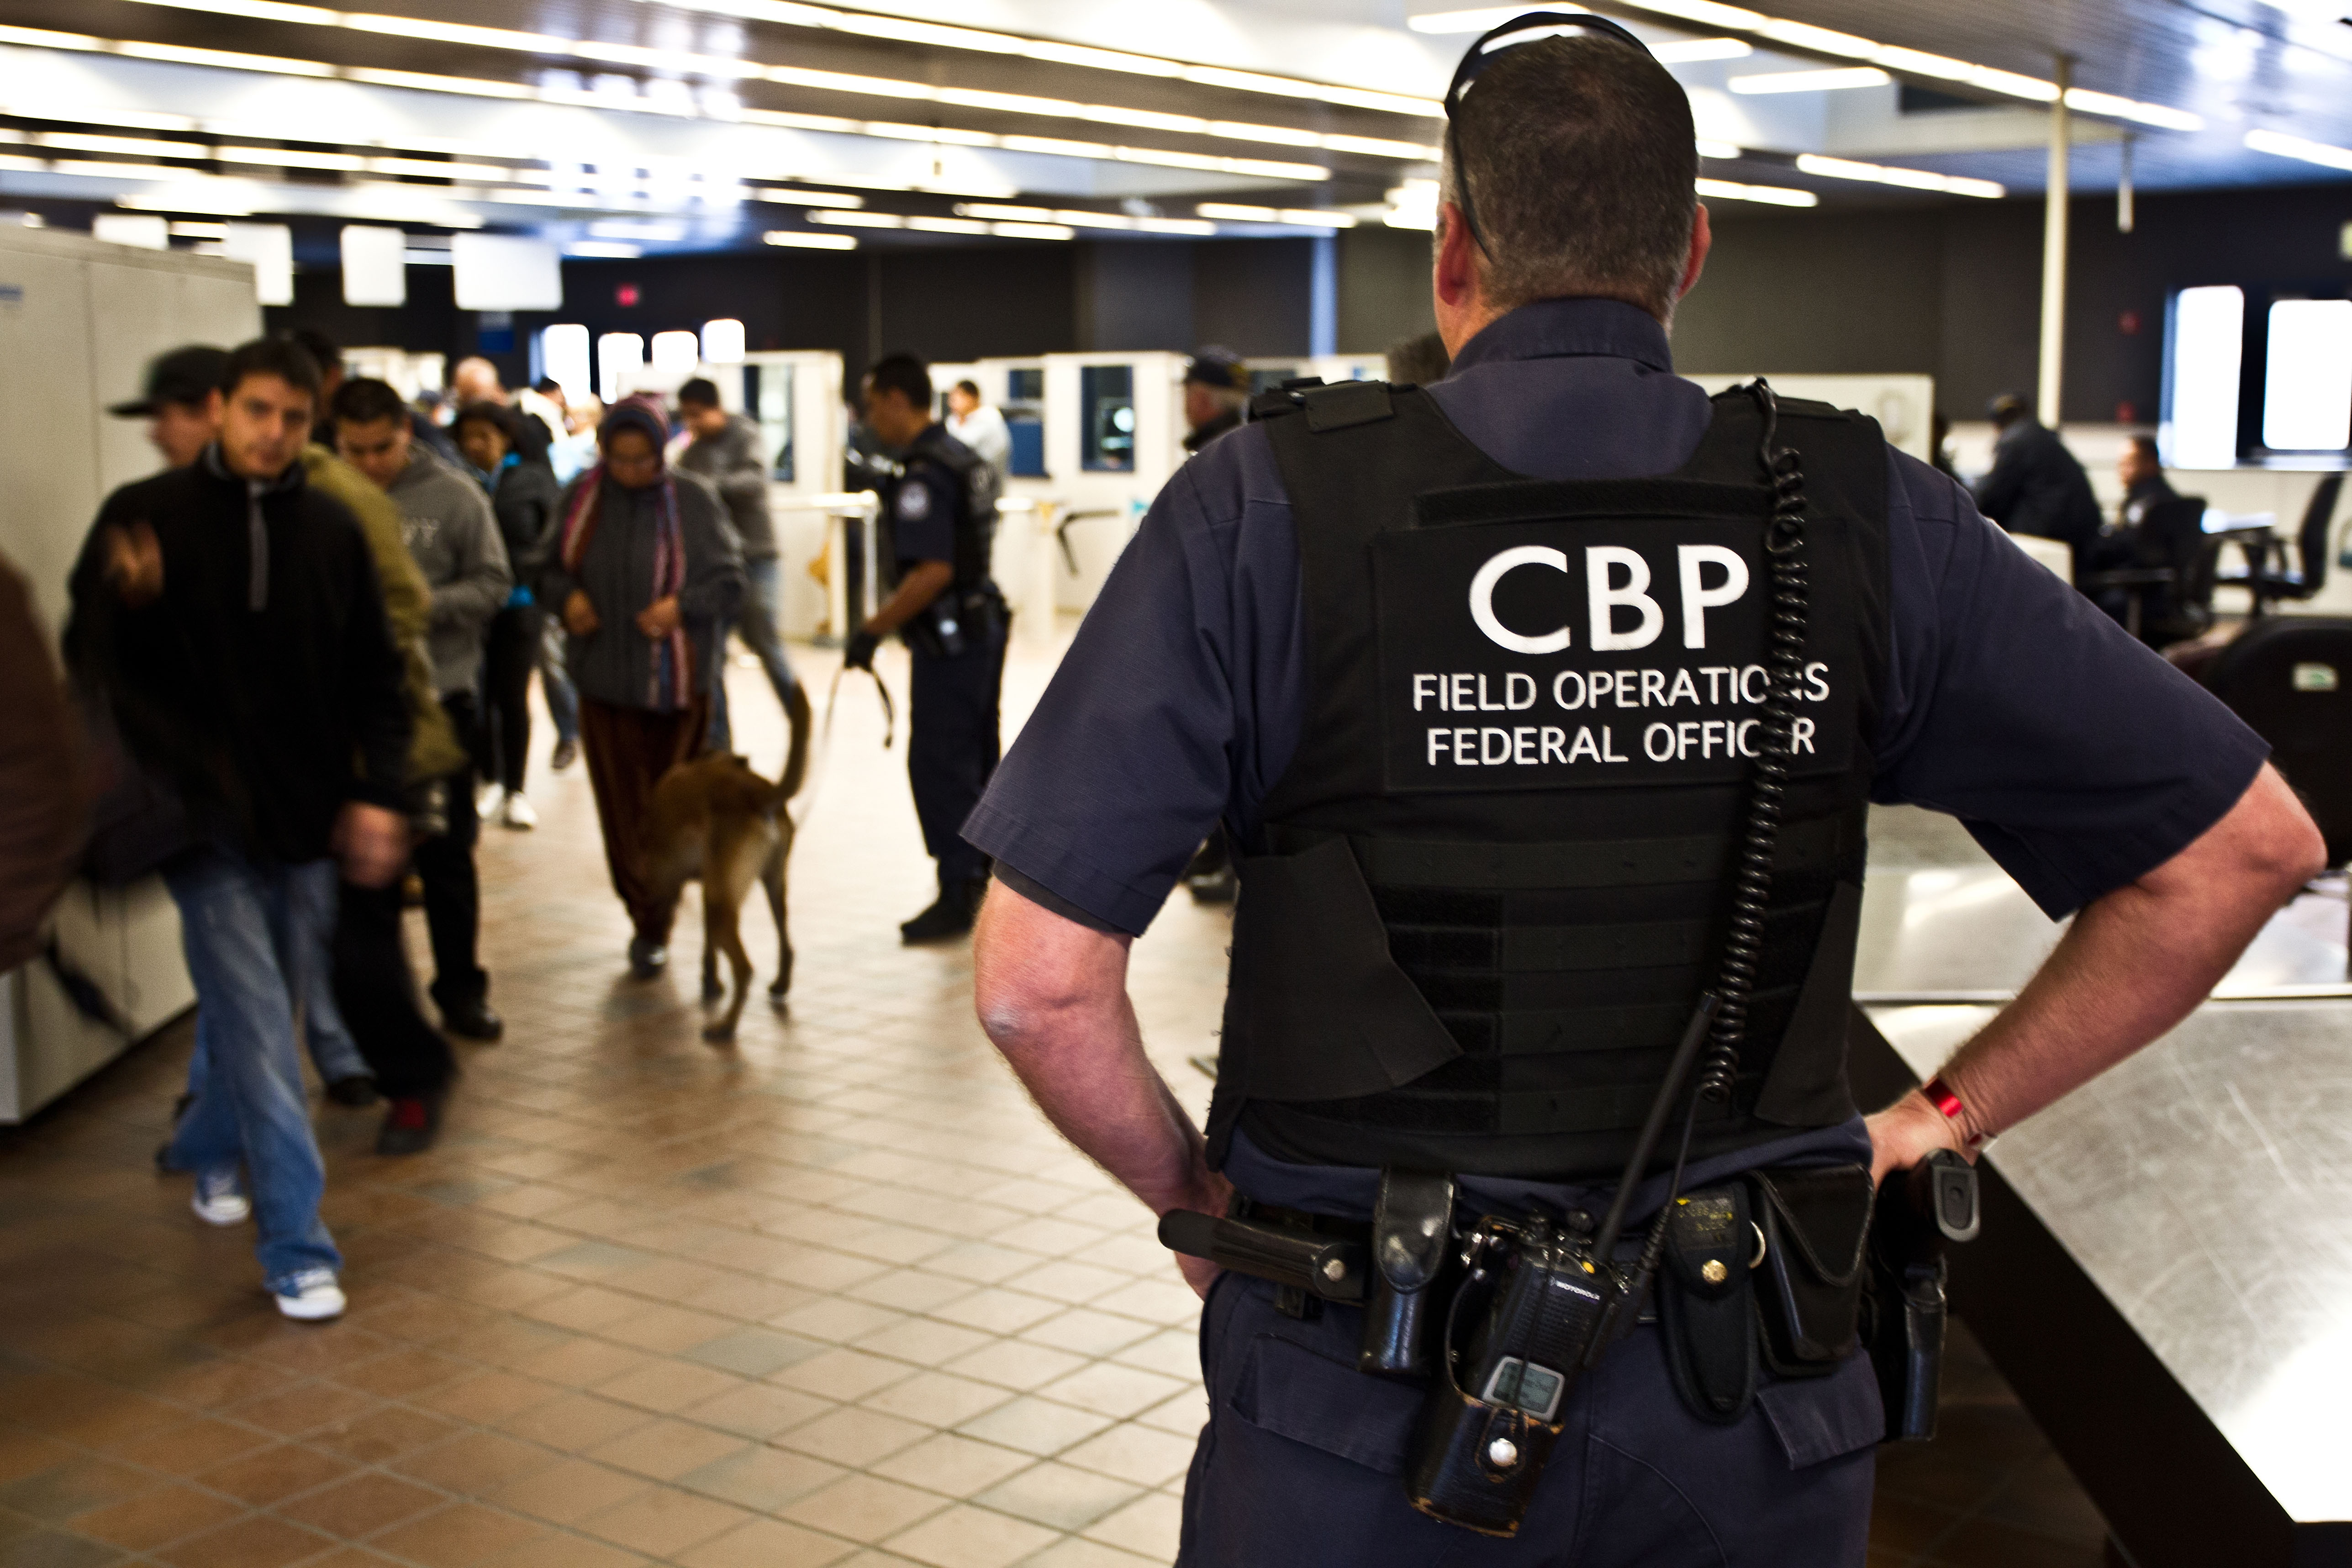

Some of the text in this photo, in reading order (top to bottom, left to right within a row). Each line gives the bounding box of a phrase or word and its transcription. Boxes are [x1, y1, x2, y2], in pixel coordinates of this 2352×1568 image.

[1469, 544, 1749, 654] CBP
[1413, 662, 1830, 711] FIELD OPERATIOS
[1428, 717, 1815, 766] FEDERAL OFFICR
